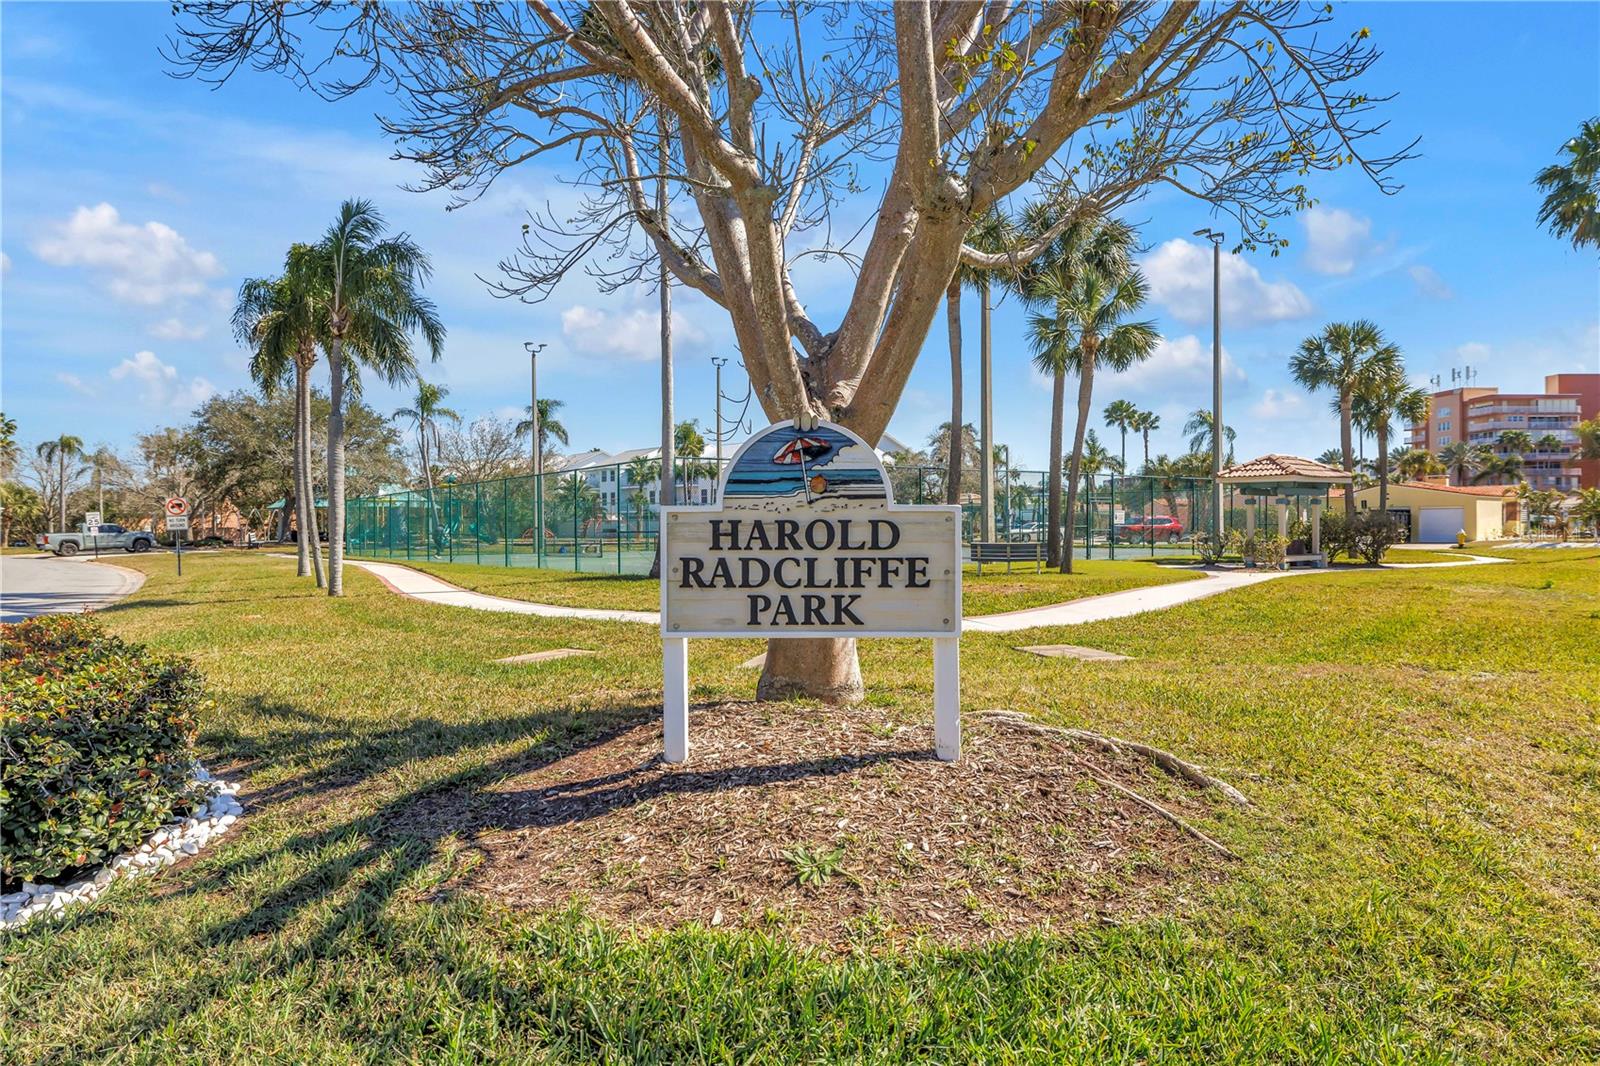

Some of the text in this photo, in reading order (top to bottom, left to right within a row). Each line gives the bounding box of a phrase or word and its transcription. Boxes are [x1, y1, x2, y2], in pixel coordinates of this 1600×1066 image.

[708, 519, 901, 551] HAROLD
[678, 557, 932, 589] RADCLIFFE
[746, 595, 865, 626] PARK
